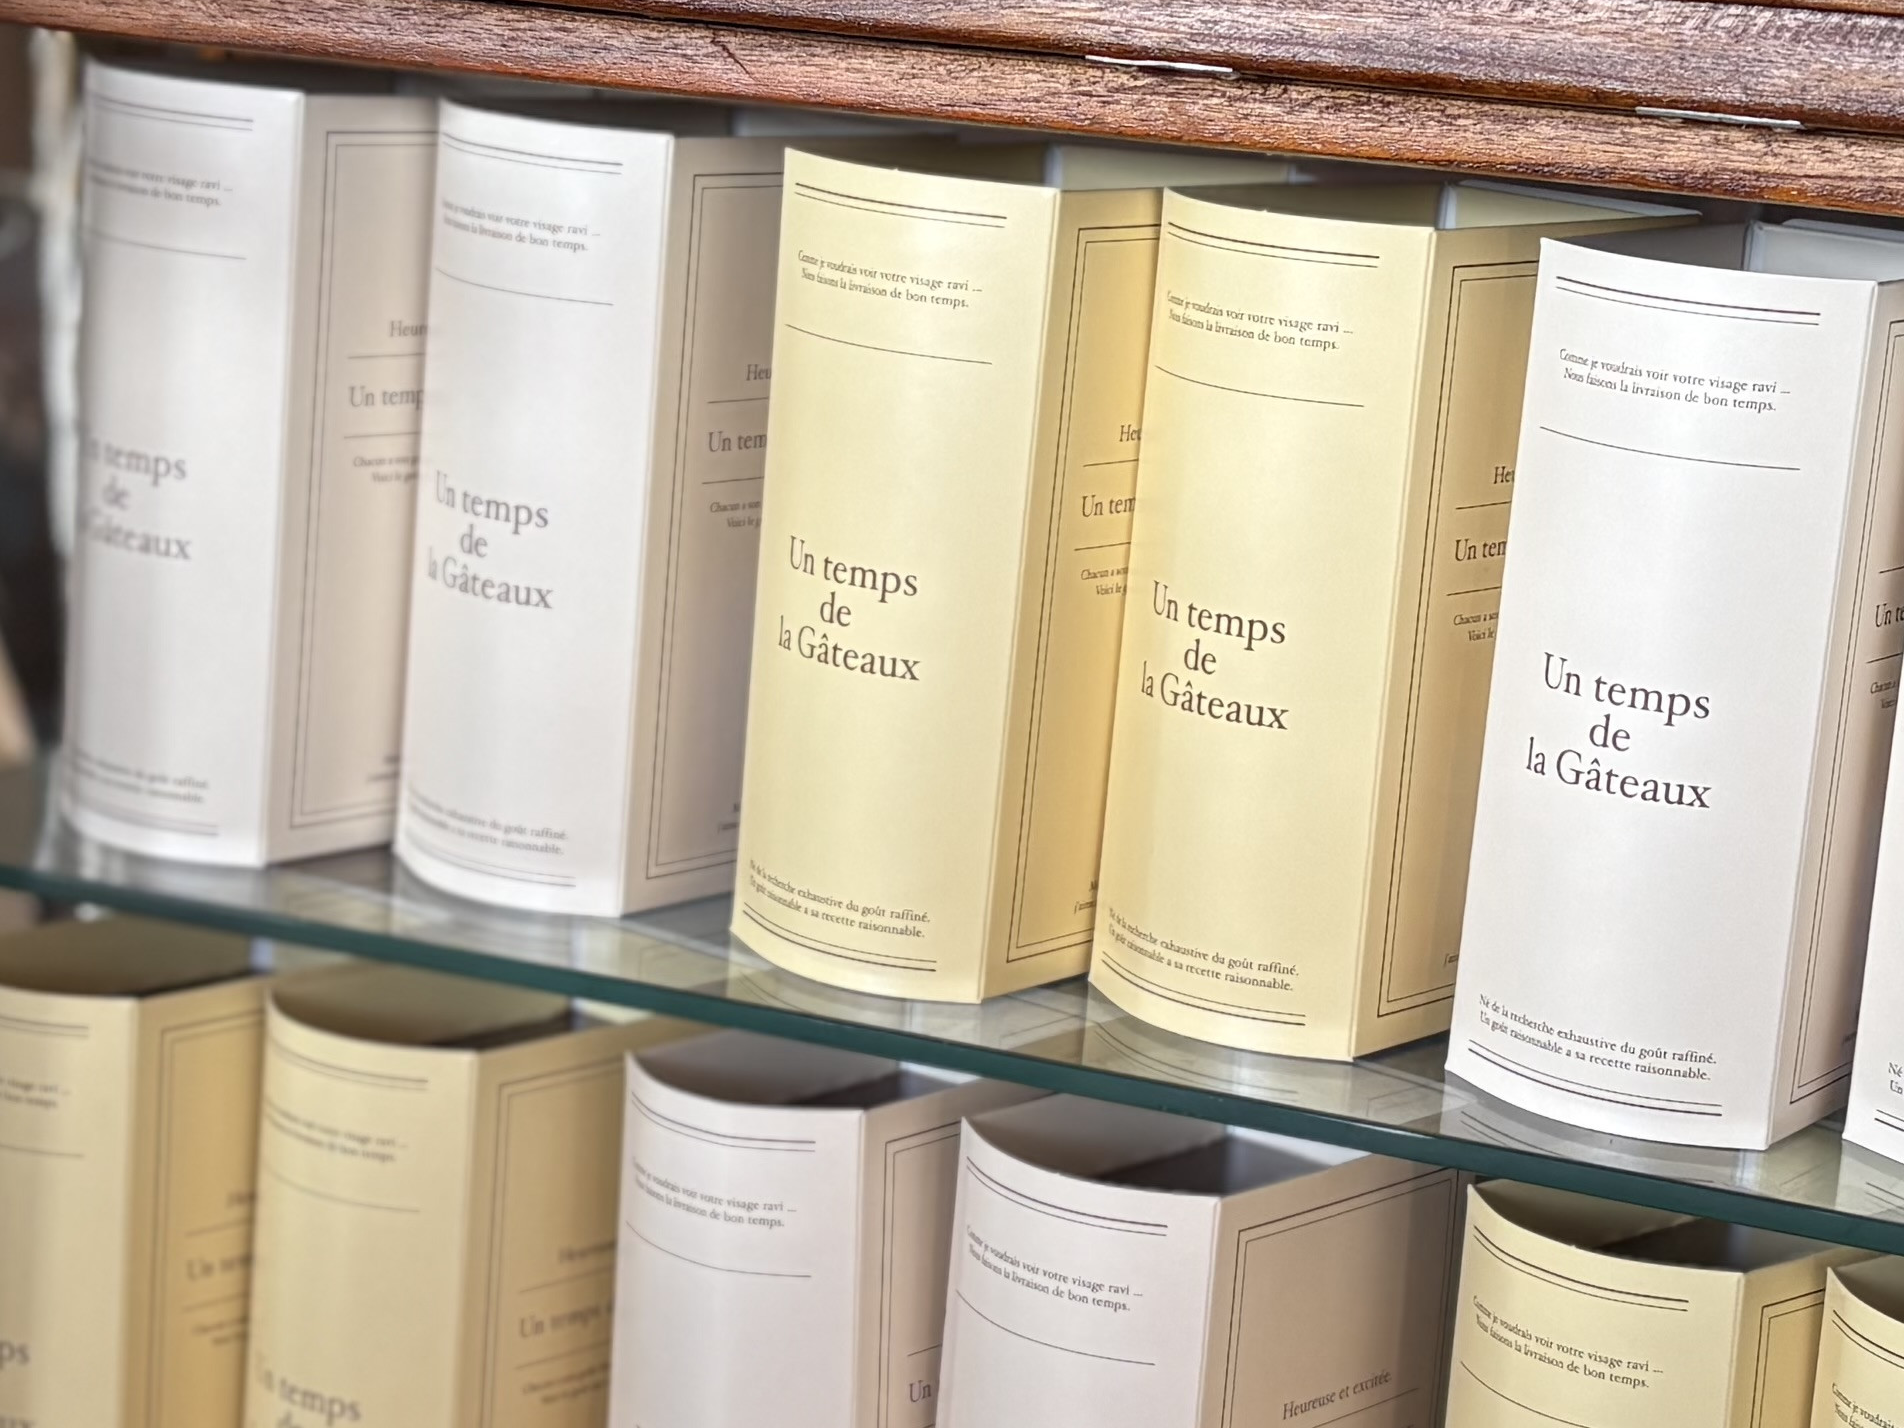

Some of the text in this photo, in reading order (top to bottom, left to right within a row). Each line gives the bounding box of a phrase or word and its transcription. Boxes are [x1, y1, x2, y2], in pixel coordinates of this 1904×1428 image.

[1153, 579, 1286, 651] Un temps
[1184, 638, 1217, 675] de
[1544, 651, 1710, 727] Un temps
[1141, 660, 1289, 730] la Gâteaux
[1589, 713, 1630, 752] de
[1526, 736, 1712, 809] la Gâteaux
[1282, 1390, 1336, 1421] Heureuse
